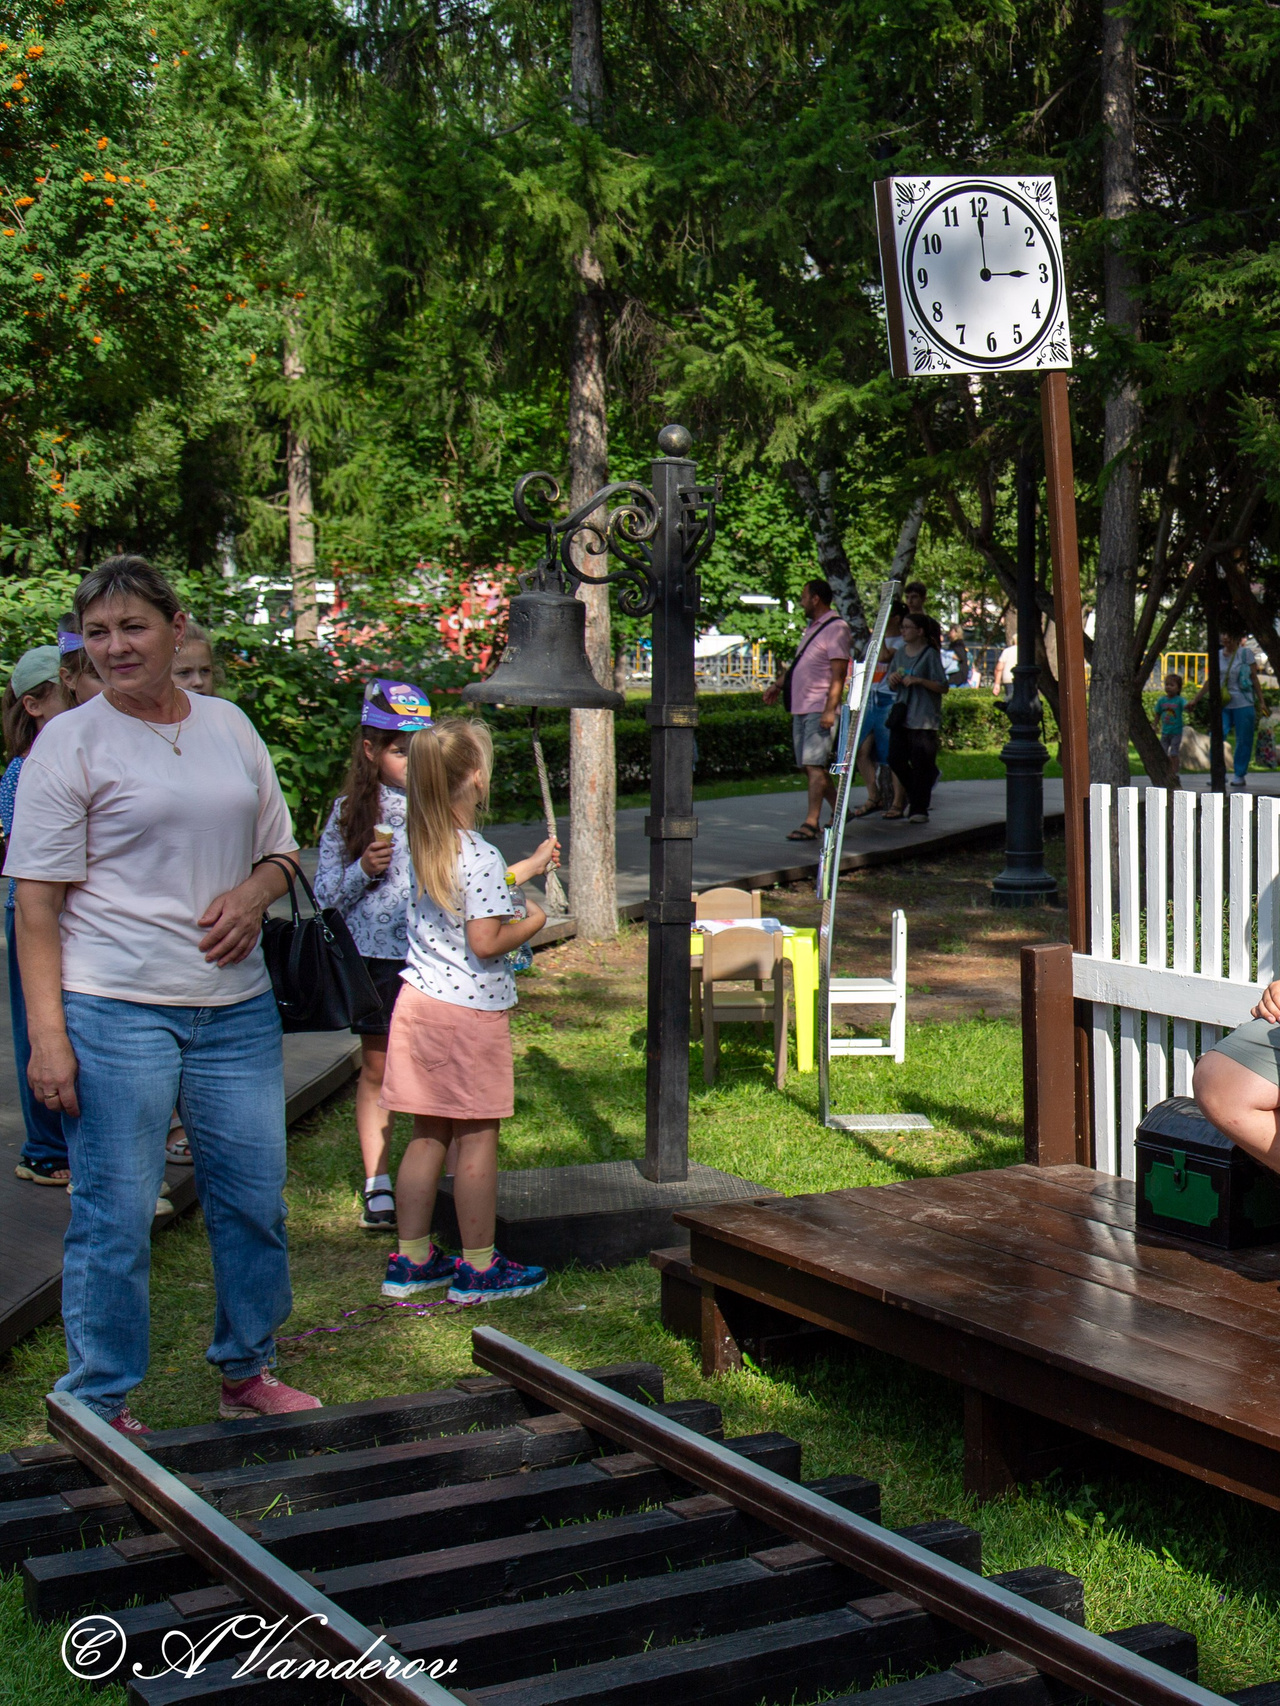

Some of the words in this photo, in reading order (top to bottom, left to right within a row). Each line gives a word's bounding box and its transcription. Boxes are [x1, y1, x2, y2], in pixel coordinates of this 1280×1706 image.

[942, 206, 959, 227] 11
[969, 197, 989, 217] 12
[1002, 205, 1010, 225] 1
[922, 233, 942, 254] 10
[1025, 227, 1035, 247] 2
[917, 268, 928, 288] 9
[1039, 263, 1048, 283] 3
[932, 302, 943, 322] 8
[1031, 299, 1041, 318] 4
[956, 324, 966, 344] 7
[987, 332, 997, 352] 6
[1013, 324, 1022, 344] 5
